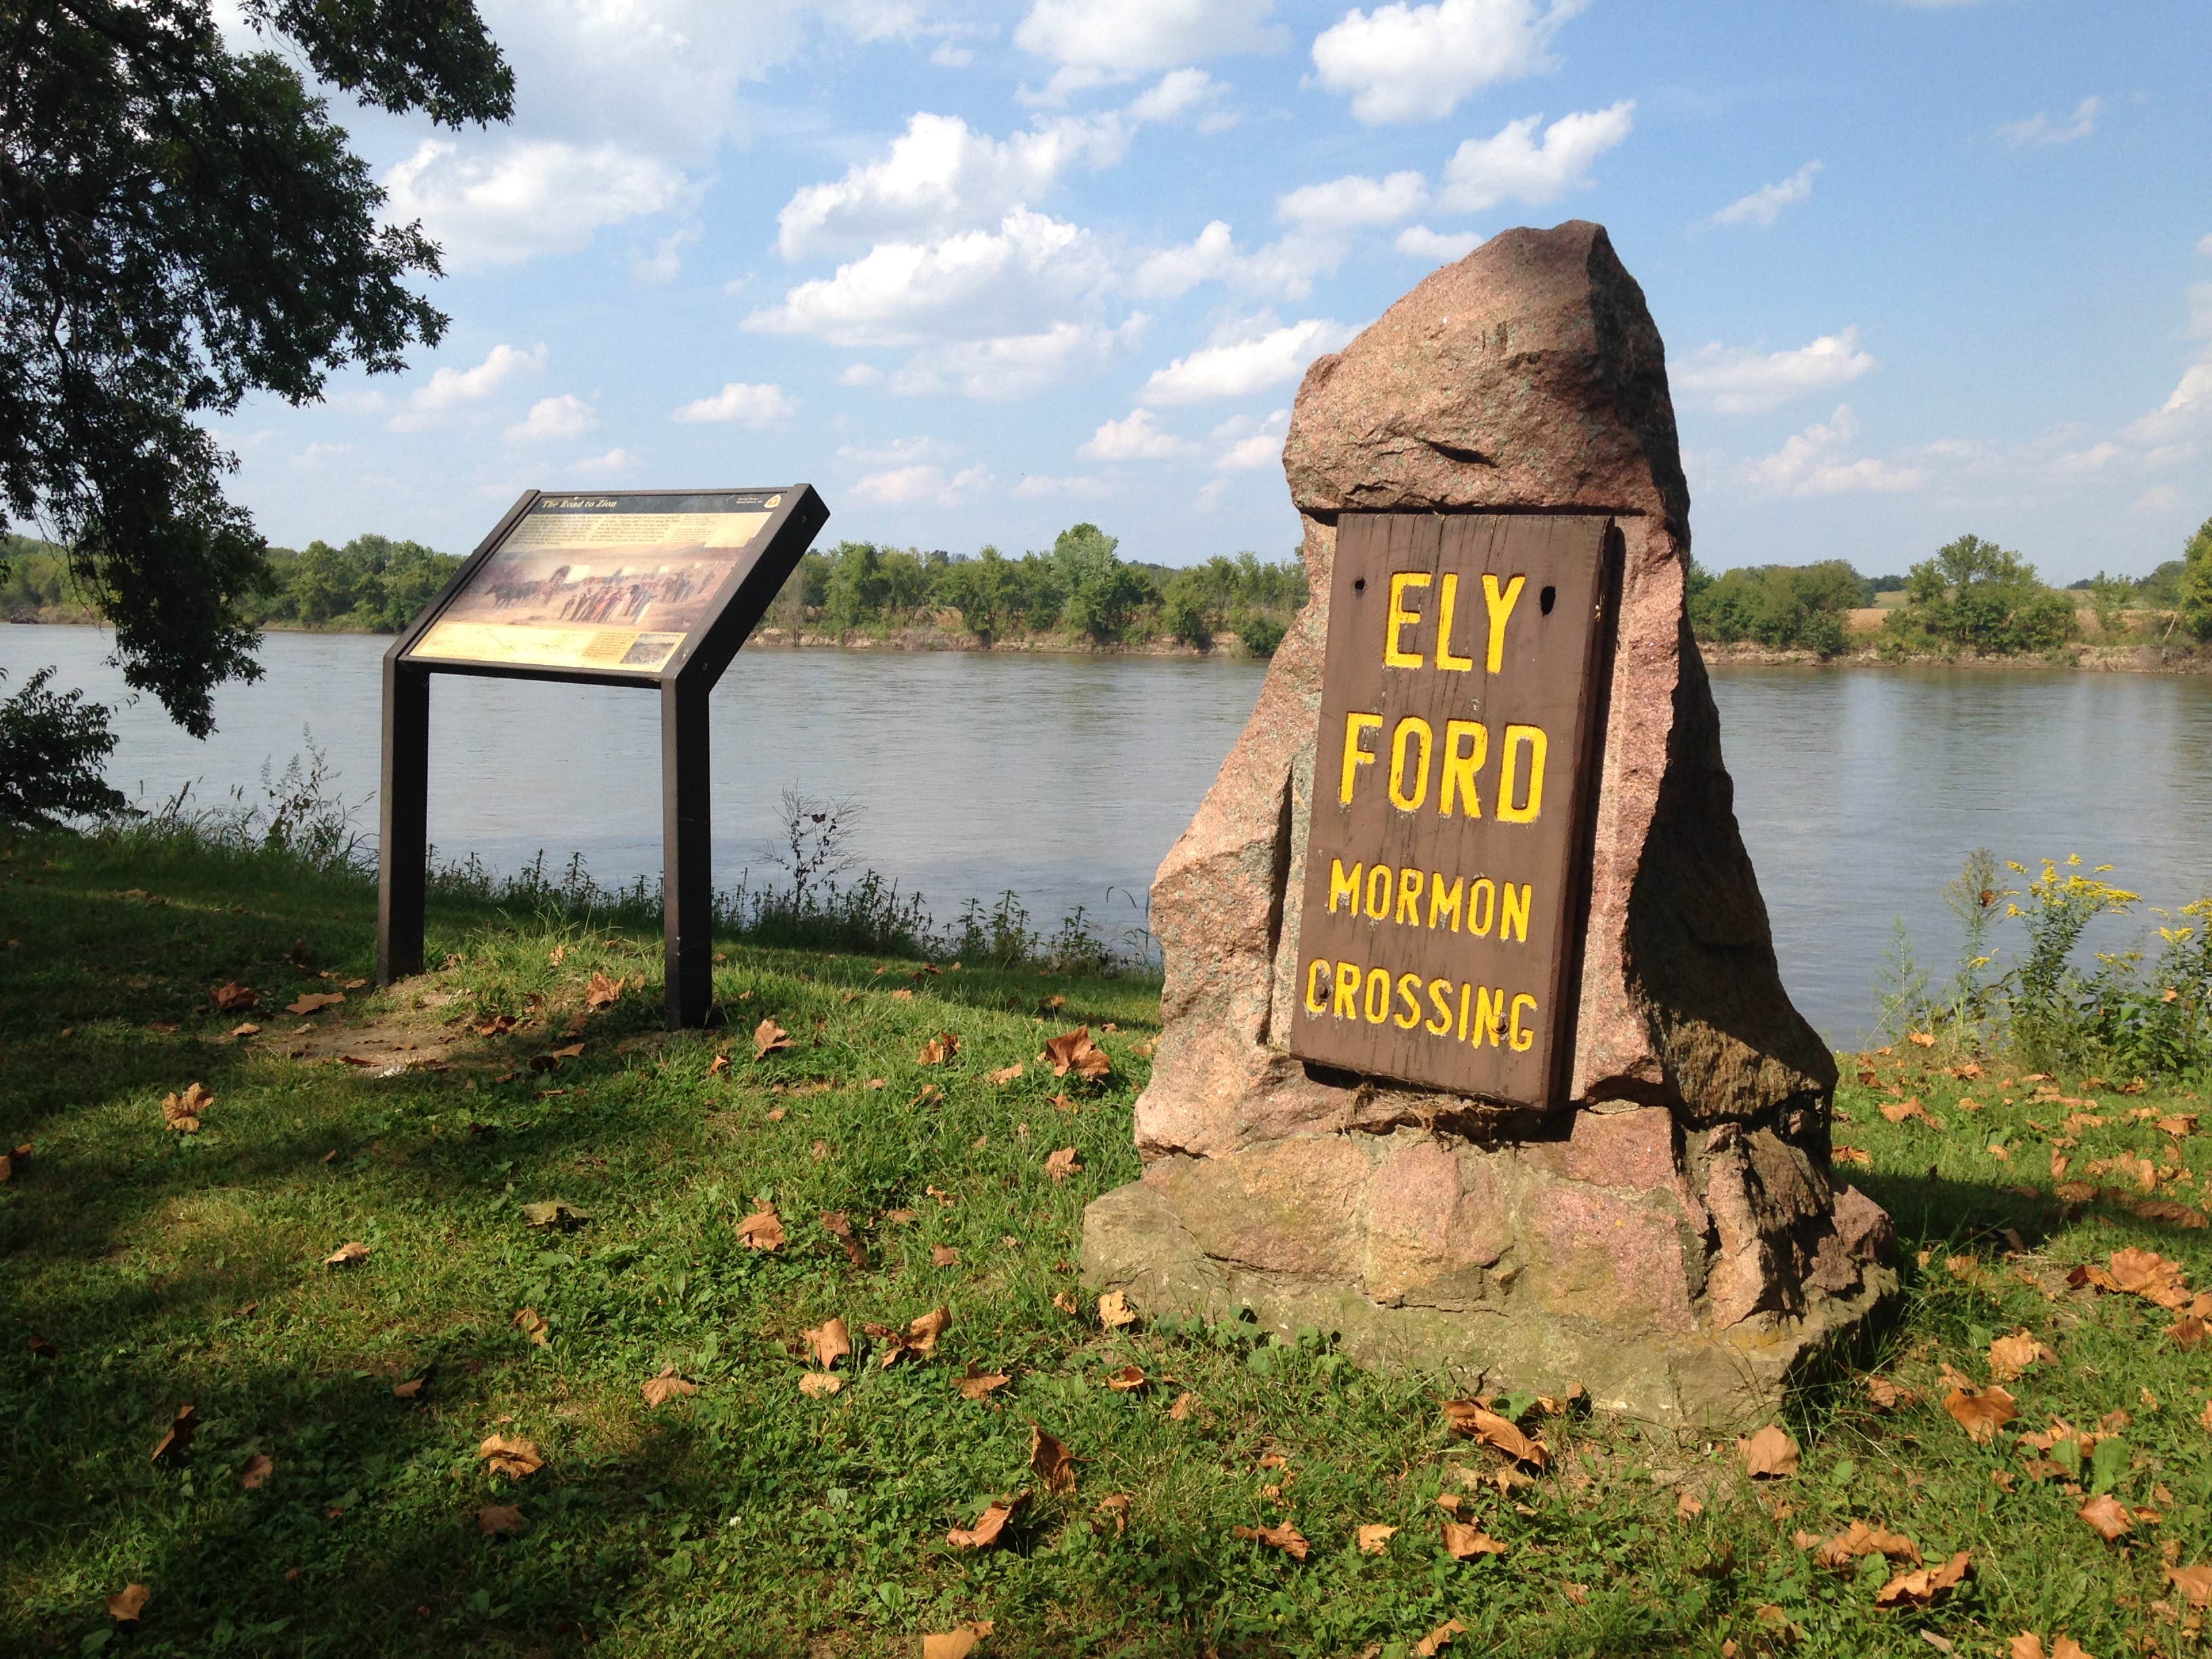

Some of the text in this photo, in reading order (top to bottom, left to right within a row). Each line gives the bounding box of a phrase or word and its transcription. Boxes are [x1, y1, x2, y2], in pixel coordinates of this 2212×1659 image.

[542, 500, 558, 508] The
[560, 499, 584, 508] Road
[596, 499, 618, 508] Zion
[1382, 573, 1525, 674] ELY
[1338, 712, 1548, 824] FORD
[1326, 858, 1532, 943] MORMON
[1305, 958, 1538, 1053] CROSSING
